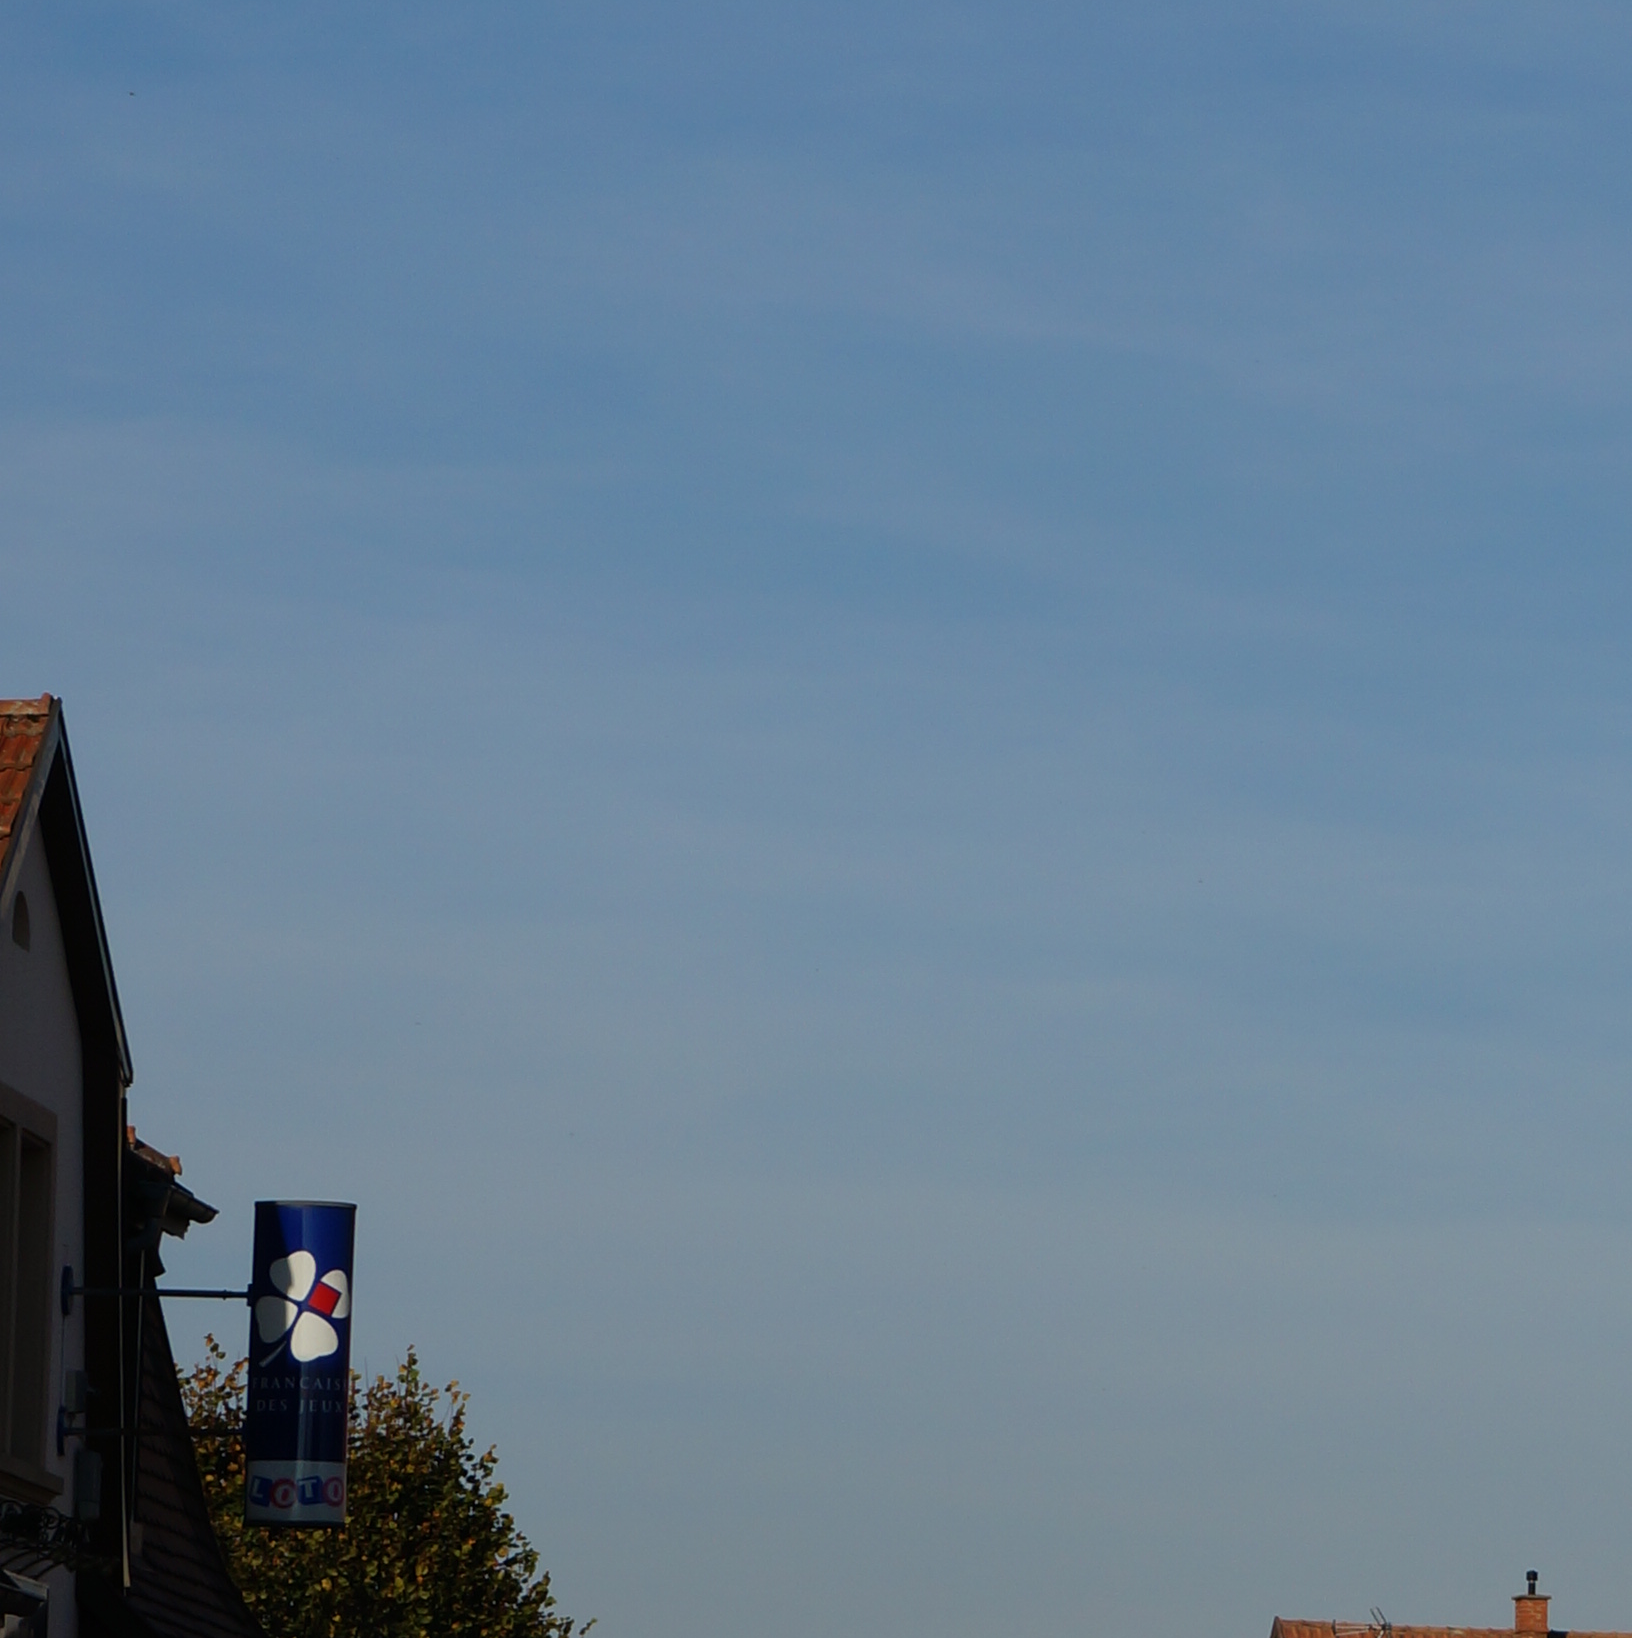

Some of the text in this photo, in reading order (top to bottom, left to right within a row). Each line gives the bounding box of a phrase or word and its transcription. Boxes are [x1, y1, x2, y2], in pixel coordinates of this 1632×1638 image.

[256, 1399, 343, 1415] DES JEUX
[249, 1475, 344, 1507] LOTO
